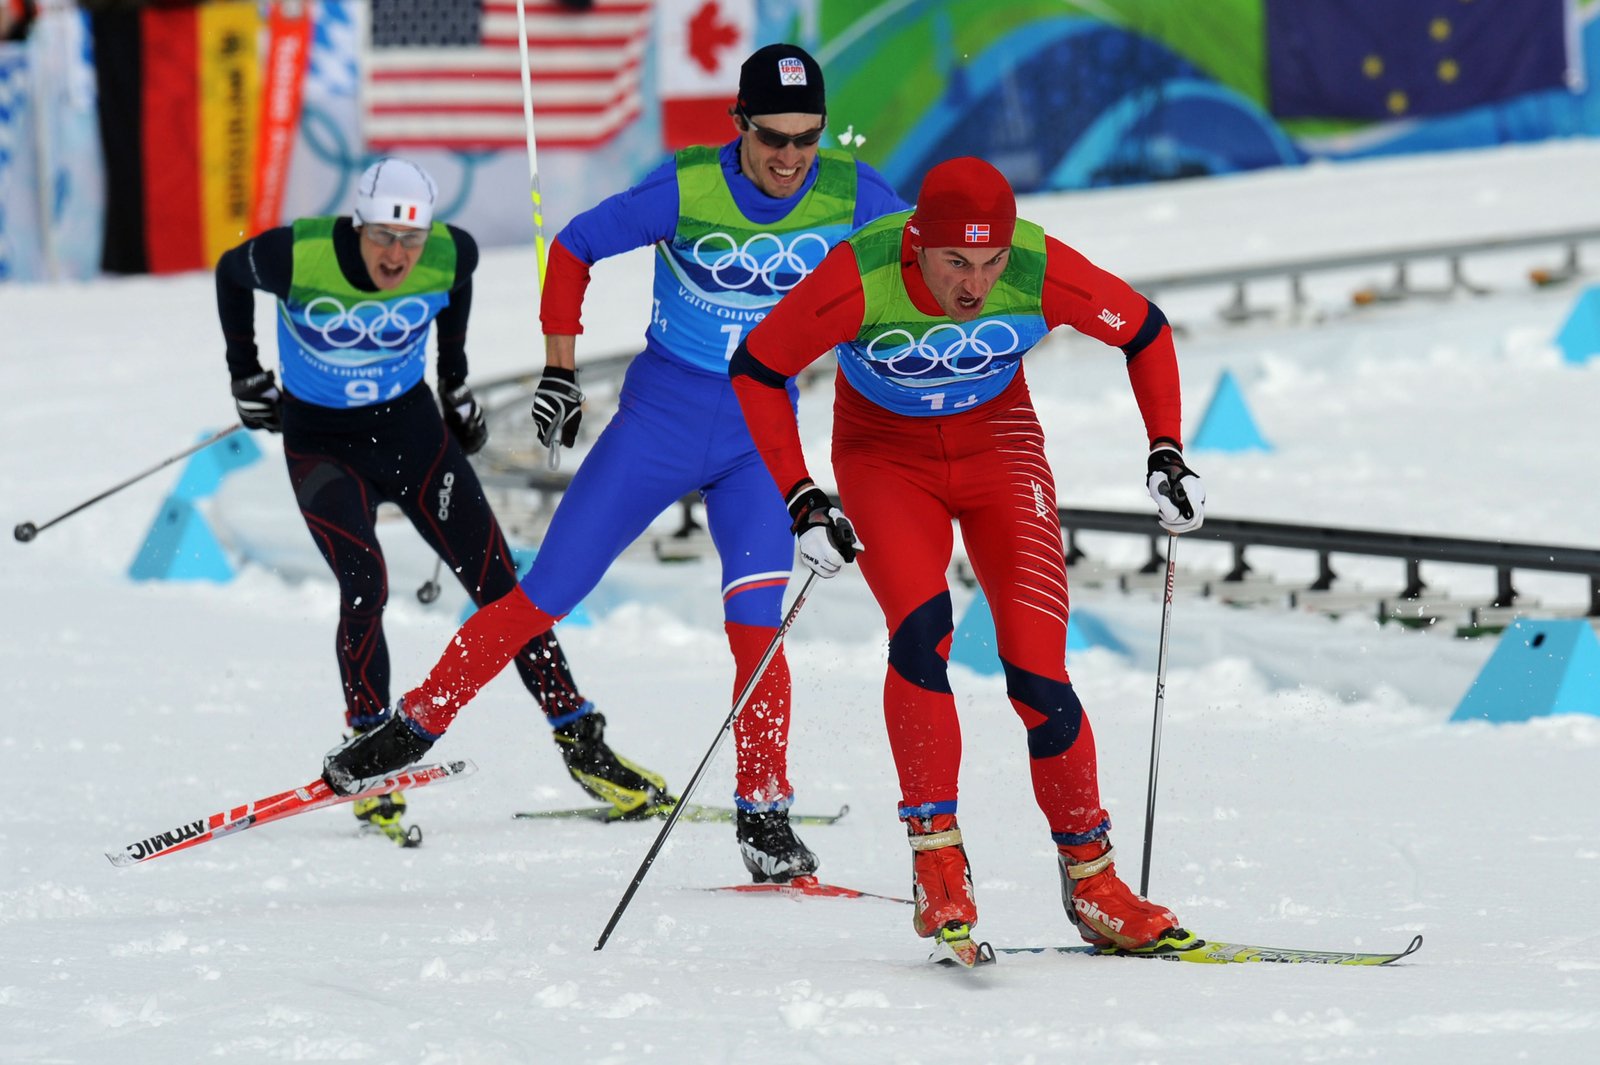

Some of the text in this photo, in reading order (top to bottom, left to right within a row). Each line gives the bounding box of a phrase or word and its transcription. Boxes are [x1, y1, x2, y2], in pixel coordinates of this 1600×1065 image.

[782, 66, 804, 74] team
[678, 285, 766, 323] vancouve
[344, 378, 379, 407] 9
[126, 819, 204, 860] ATOMIC
[1072, 895, 1125, 933] pina
